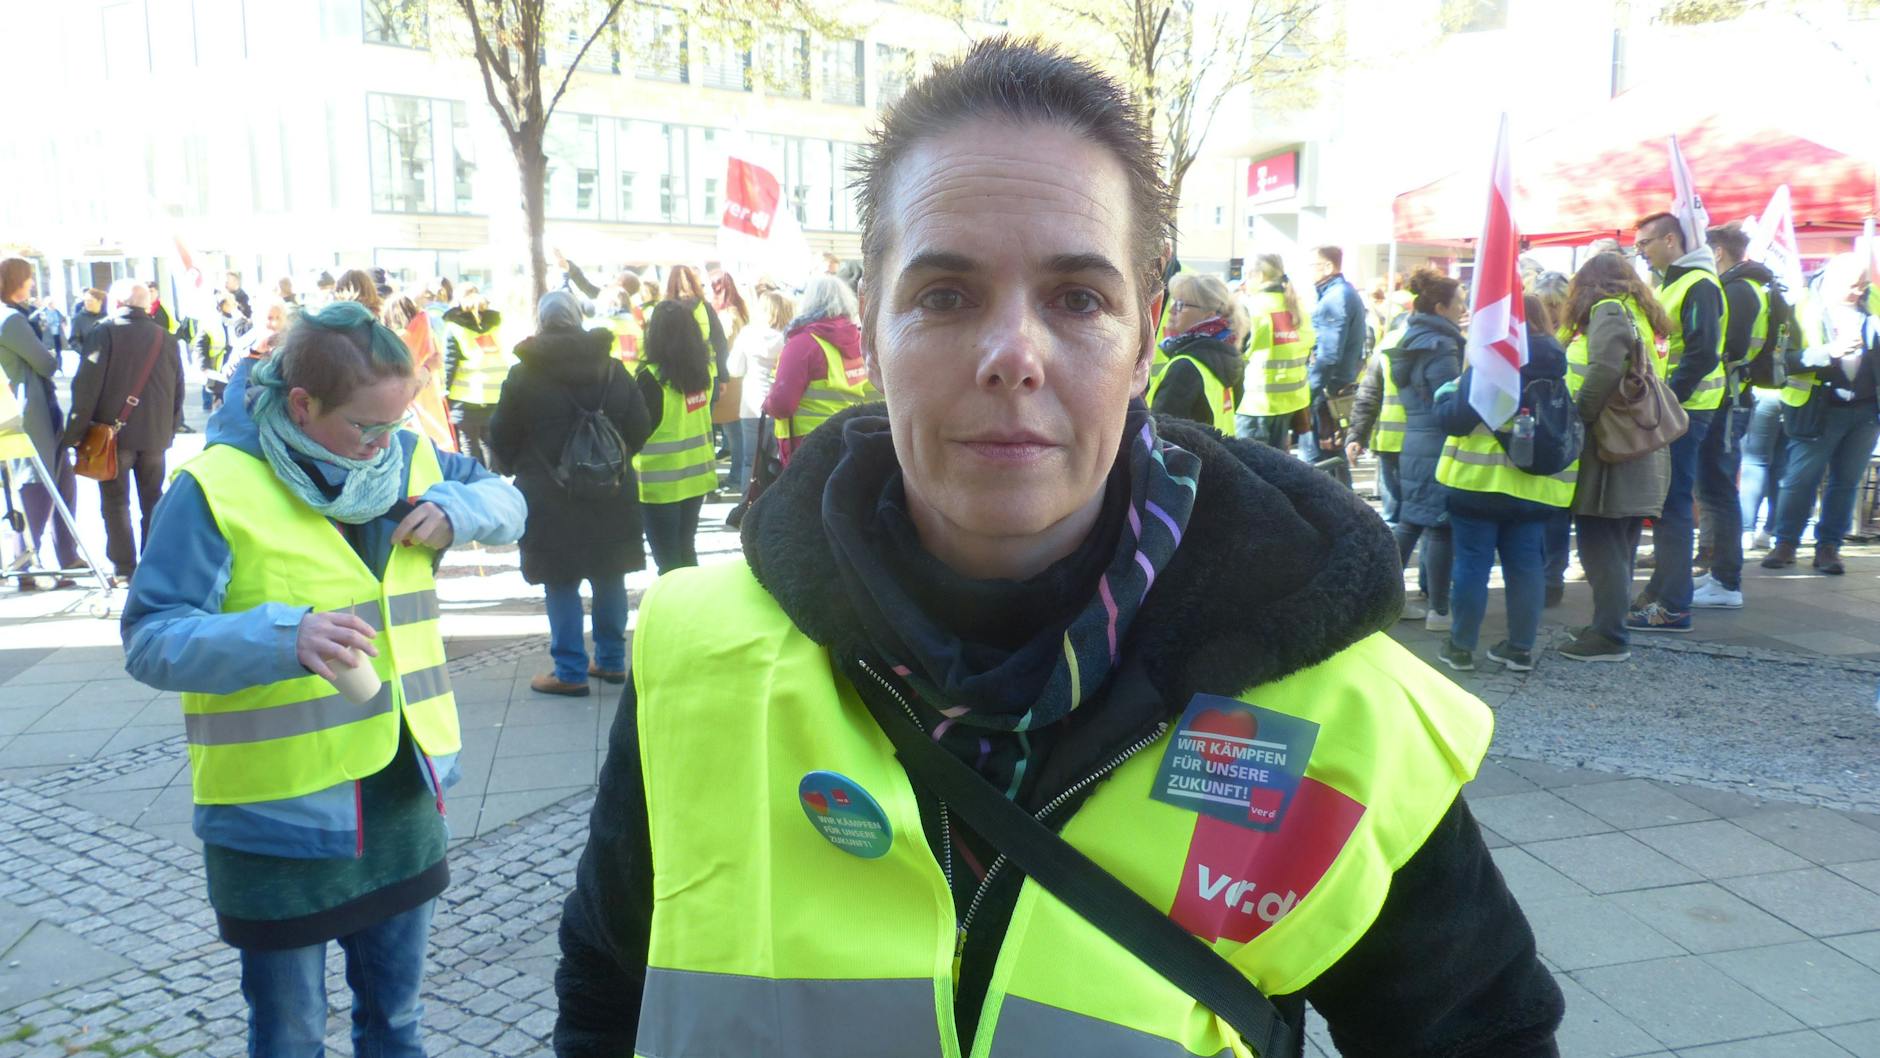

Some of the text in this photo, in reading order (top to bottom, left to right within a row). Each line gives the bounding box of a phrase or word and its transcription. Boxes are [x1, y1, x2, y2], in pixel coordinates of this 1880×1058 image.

[1177, 738, 1287, 766] WIR KÄMPFEN
[1172, 755, 1269, 783] FÜR UNSERE
[1168, 774, 1249, 800] ZUKUNFT!
[1198, 864, 1301, 926] vr.d
